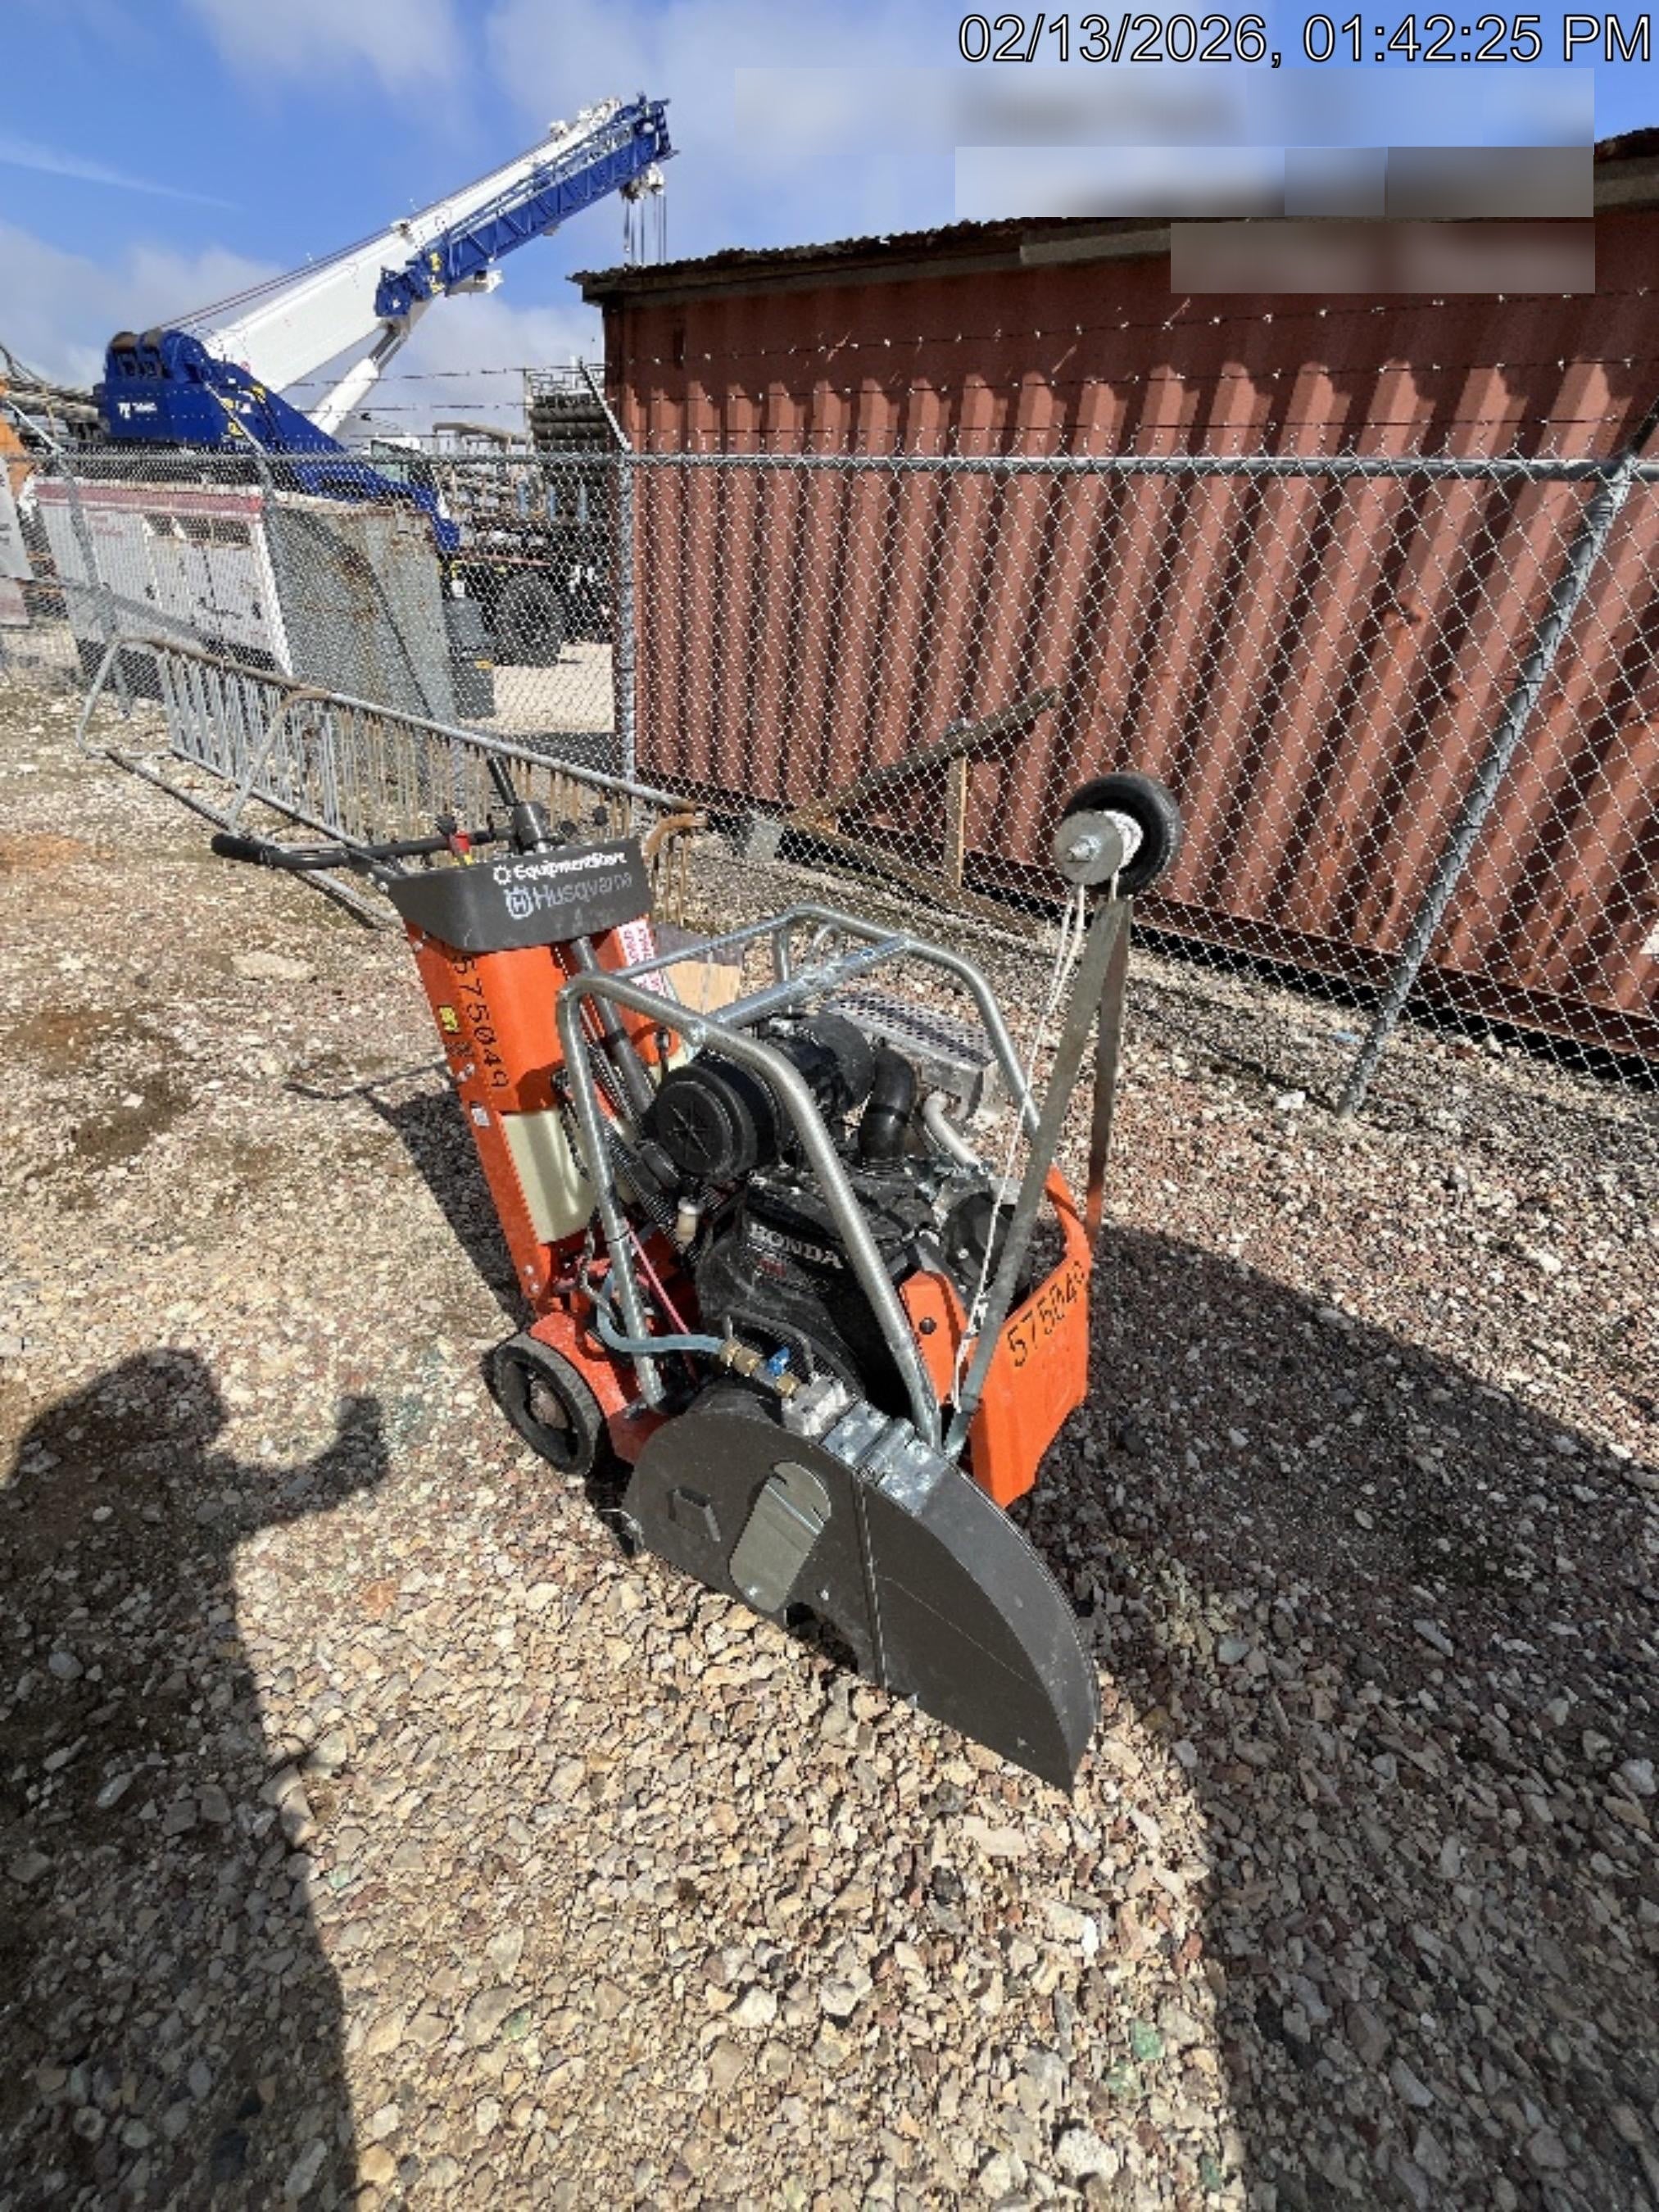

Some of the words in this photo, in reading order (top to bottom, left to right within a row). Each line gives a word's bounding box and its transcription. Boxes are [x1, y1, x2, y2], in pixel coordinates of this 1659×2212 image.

[533, 872, 632, 910] Husqvarna
[453, 955, 510, 1087] 575049
[750, 1222, 844, 1270] HONDA
